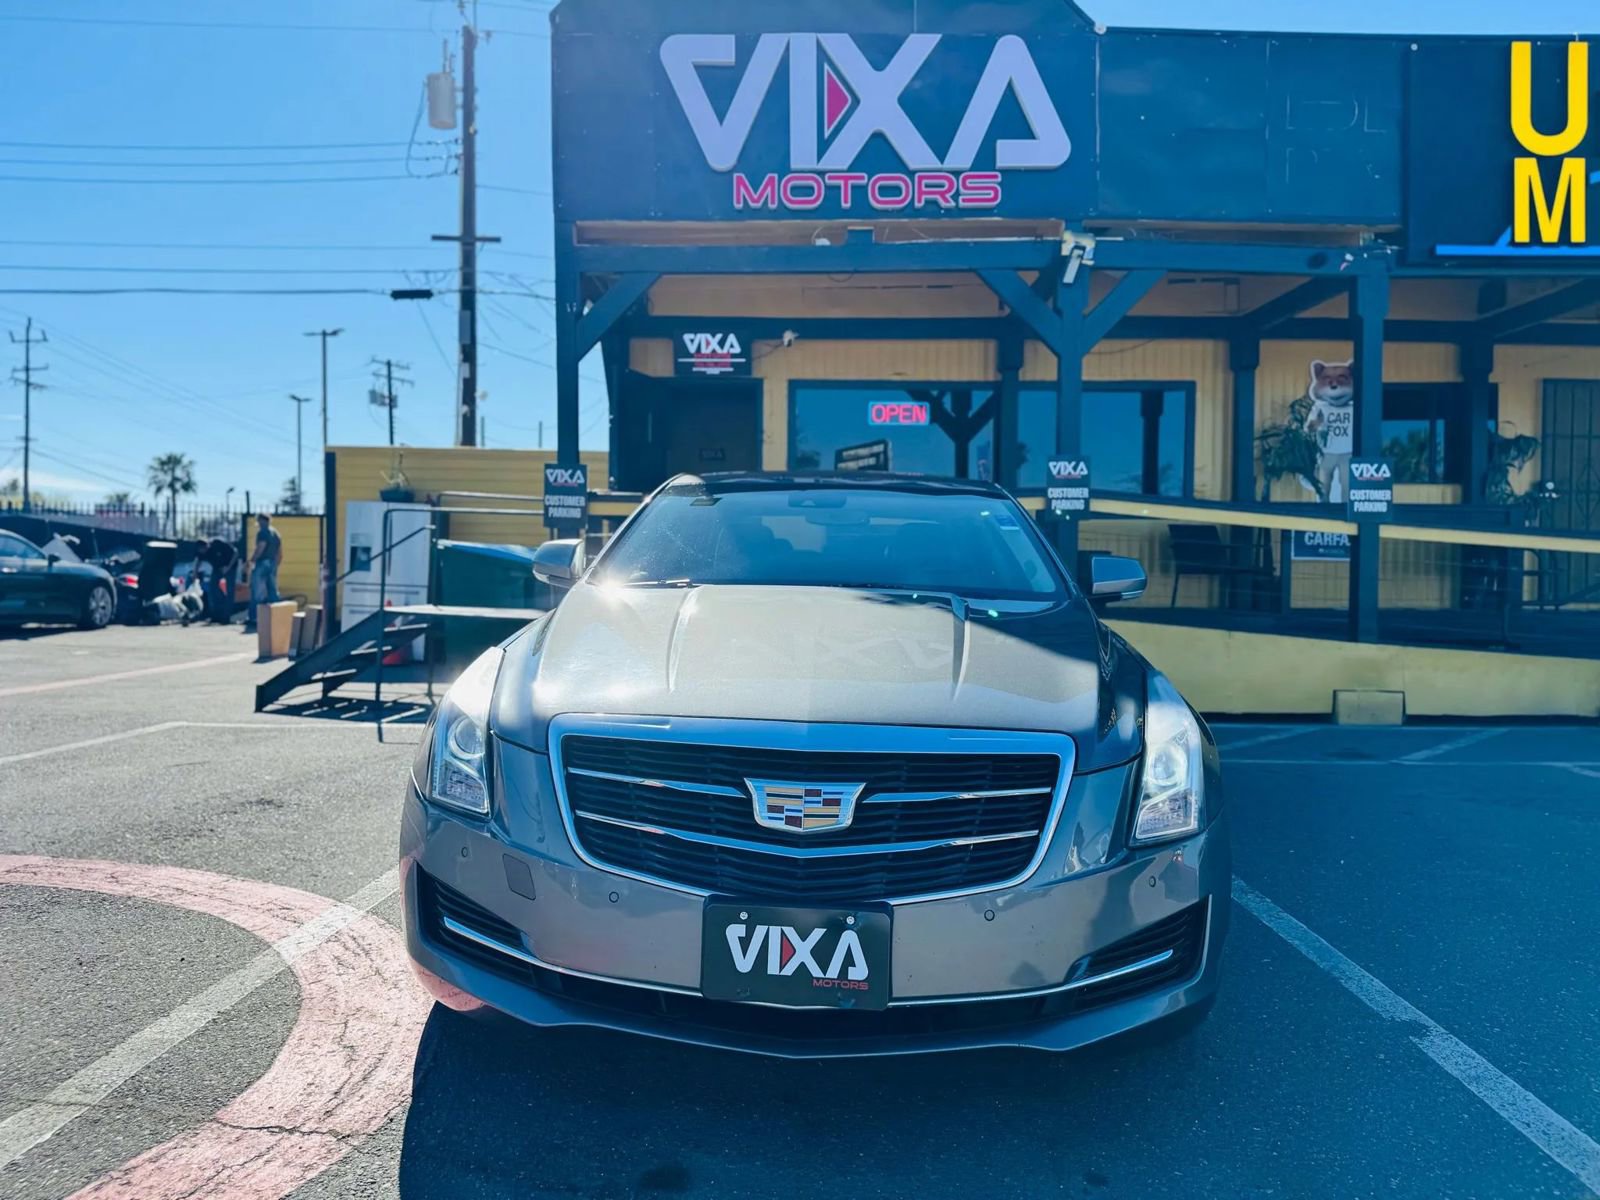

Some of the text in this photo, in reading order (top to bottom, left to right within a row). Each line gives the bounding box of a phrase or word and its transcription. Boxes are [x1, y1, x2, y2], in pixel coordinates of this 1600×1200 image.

[659, 33, 1072, 171] VIXA
[732, 172, 1002, 208] MOTORS
[682, 333, 742, 354] VIXA
[871, 403, 927, 424] OPEN
[1327, 412, 1350, 424] CAR
[1326, 425, 1349, 437] FOX
[1048, 461, 1088, 476] VIXA
[1350, 463, 1391, 478] VIXA
[545, 469, 585, 484] VIXA
[1047, 487, 1089, 498] CUSTOMER
[1350, 489, 1392, 500] CUSTOMER
[545, 495, 586, 507] CUSTOMER
[1051, 499, 1085, 510] PARKING
[1353, 501, 1388, 512] PARKING
[548, 507, 581, 519] PARKING
[1303, 532, 1350, 546] CARFA
[725, 923, 869, 981] VIXA
[812, 979, 869, 990] MOTORS
